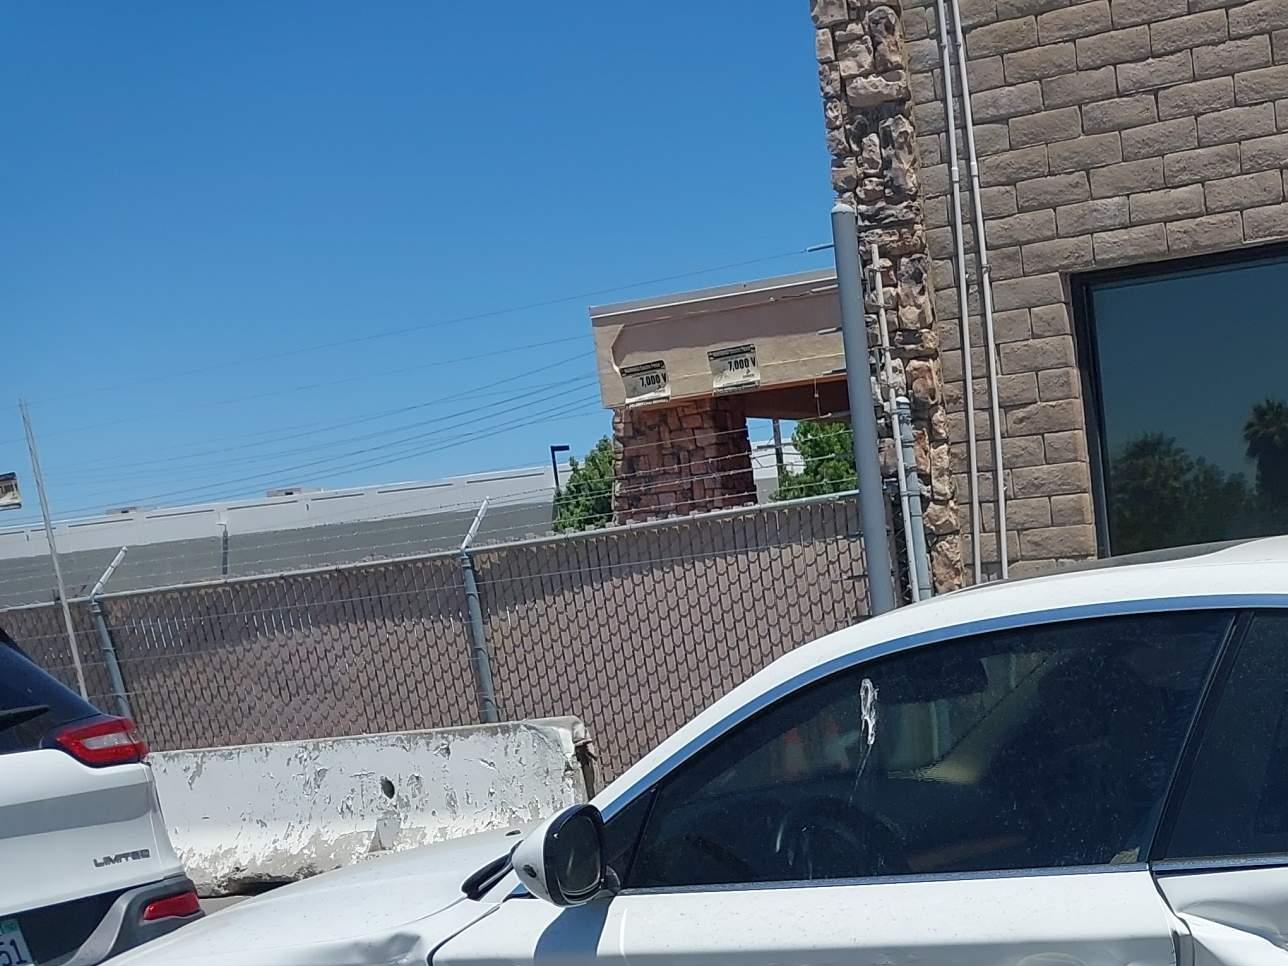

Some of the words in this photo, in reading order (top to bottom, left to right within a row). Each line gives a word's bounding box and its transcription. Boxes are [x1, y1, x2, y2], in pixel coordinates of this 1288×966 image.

[728, 358, 750, 372] 7,000
[640, 374, 661, 388] 7,000
[93, 848, 150, 868] LIMITED
